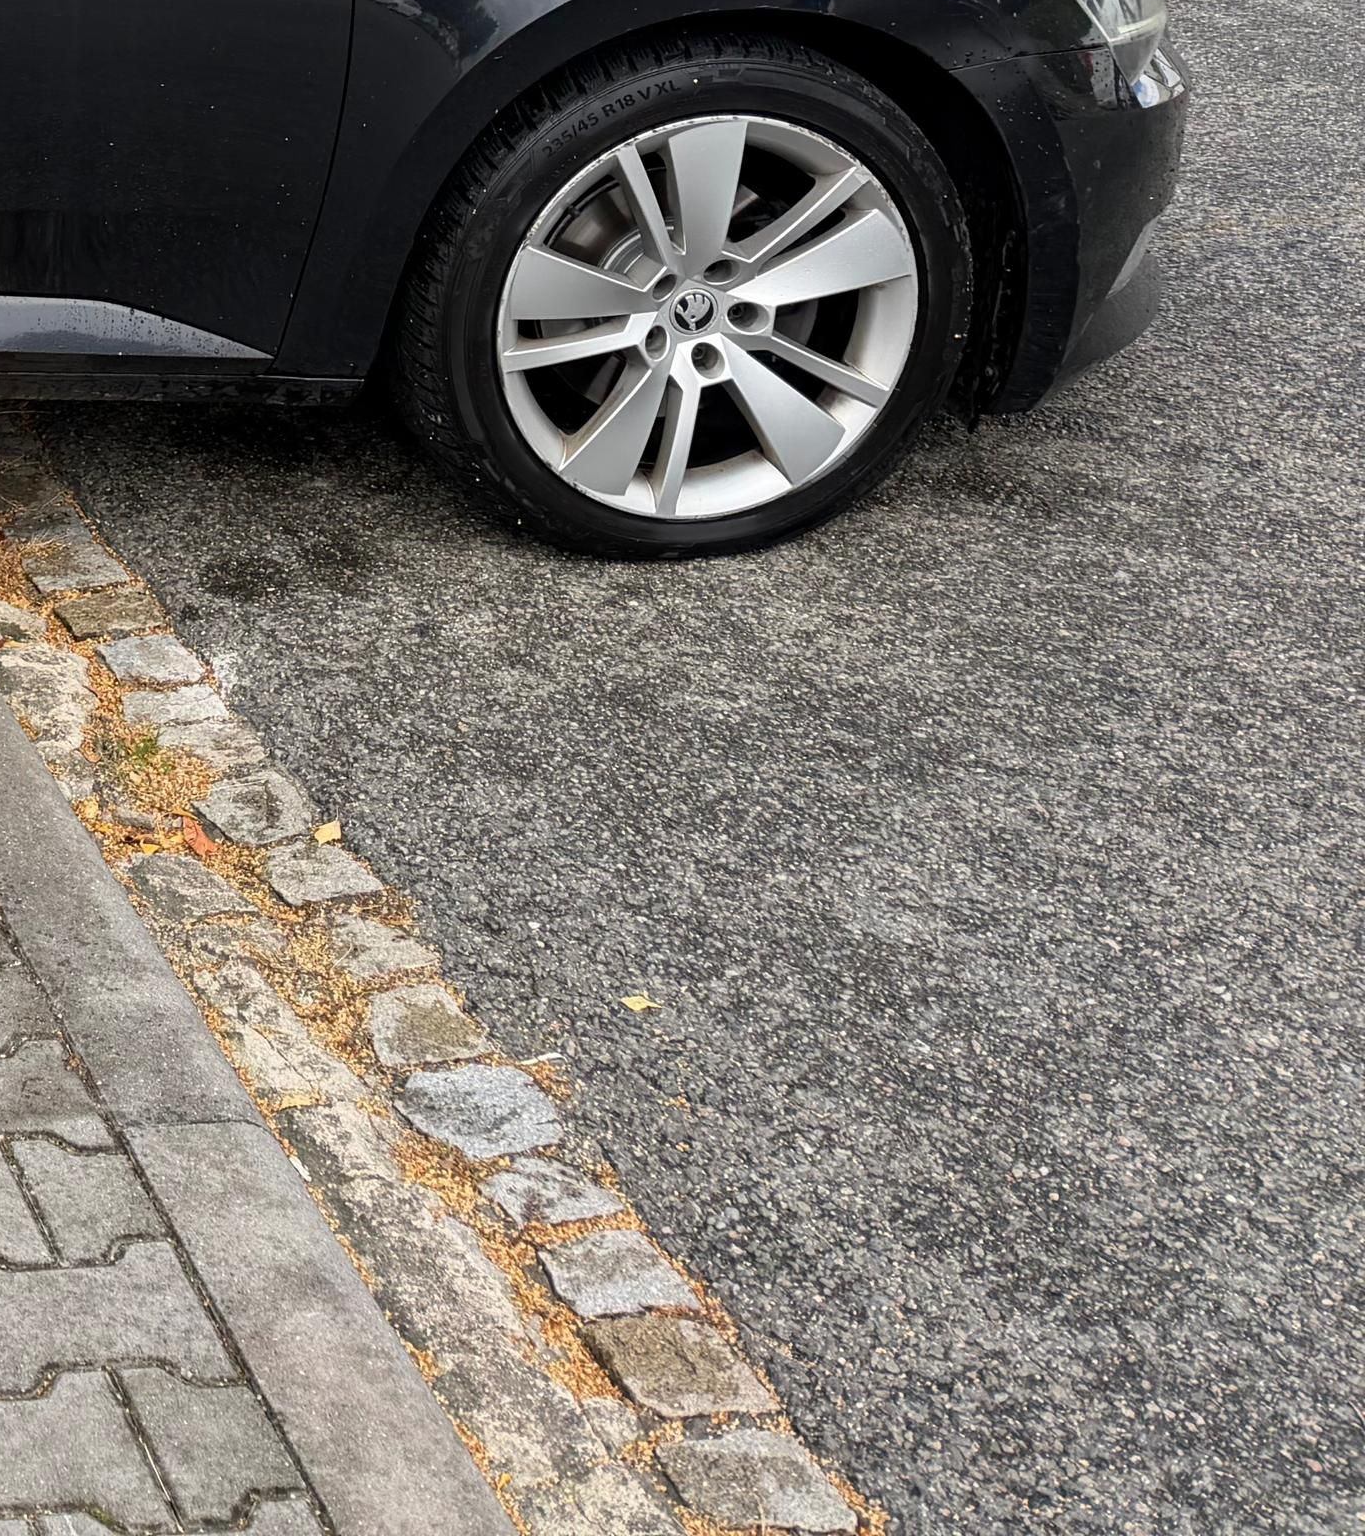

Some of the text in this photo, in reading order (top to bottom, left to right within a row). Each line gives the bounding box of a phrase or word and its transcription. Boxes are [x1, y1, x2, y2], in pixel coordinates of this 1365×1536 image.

[542, 79, 682, 157] 235/45 R18 V XL
